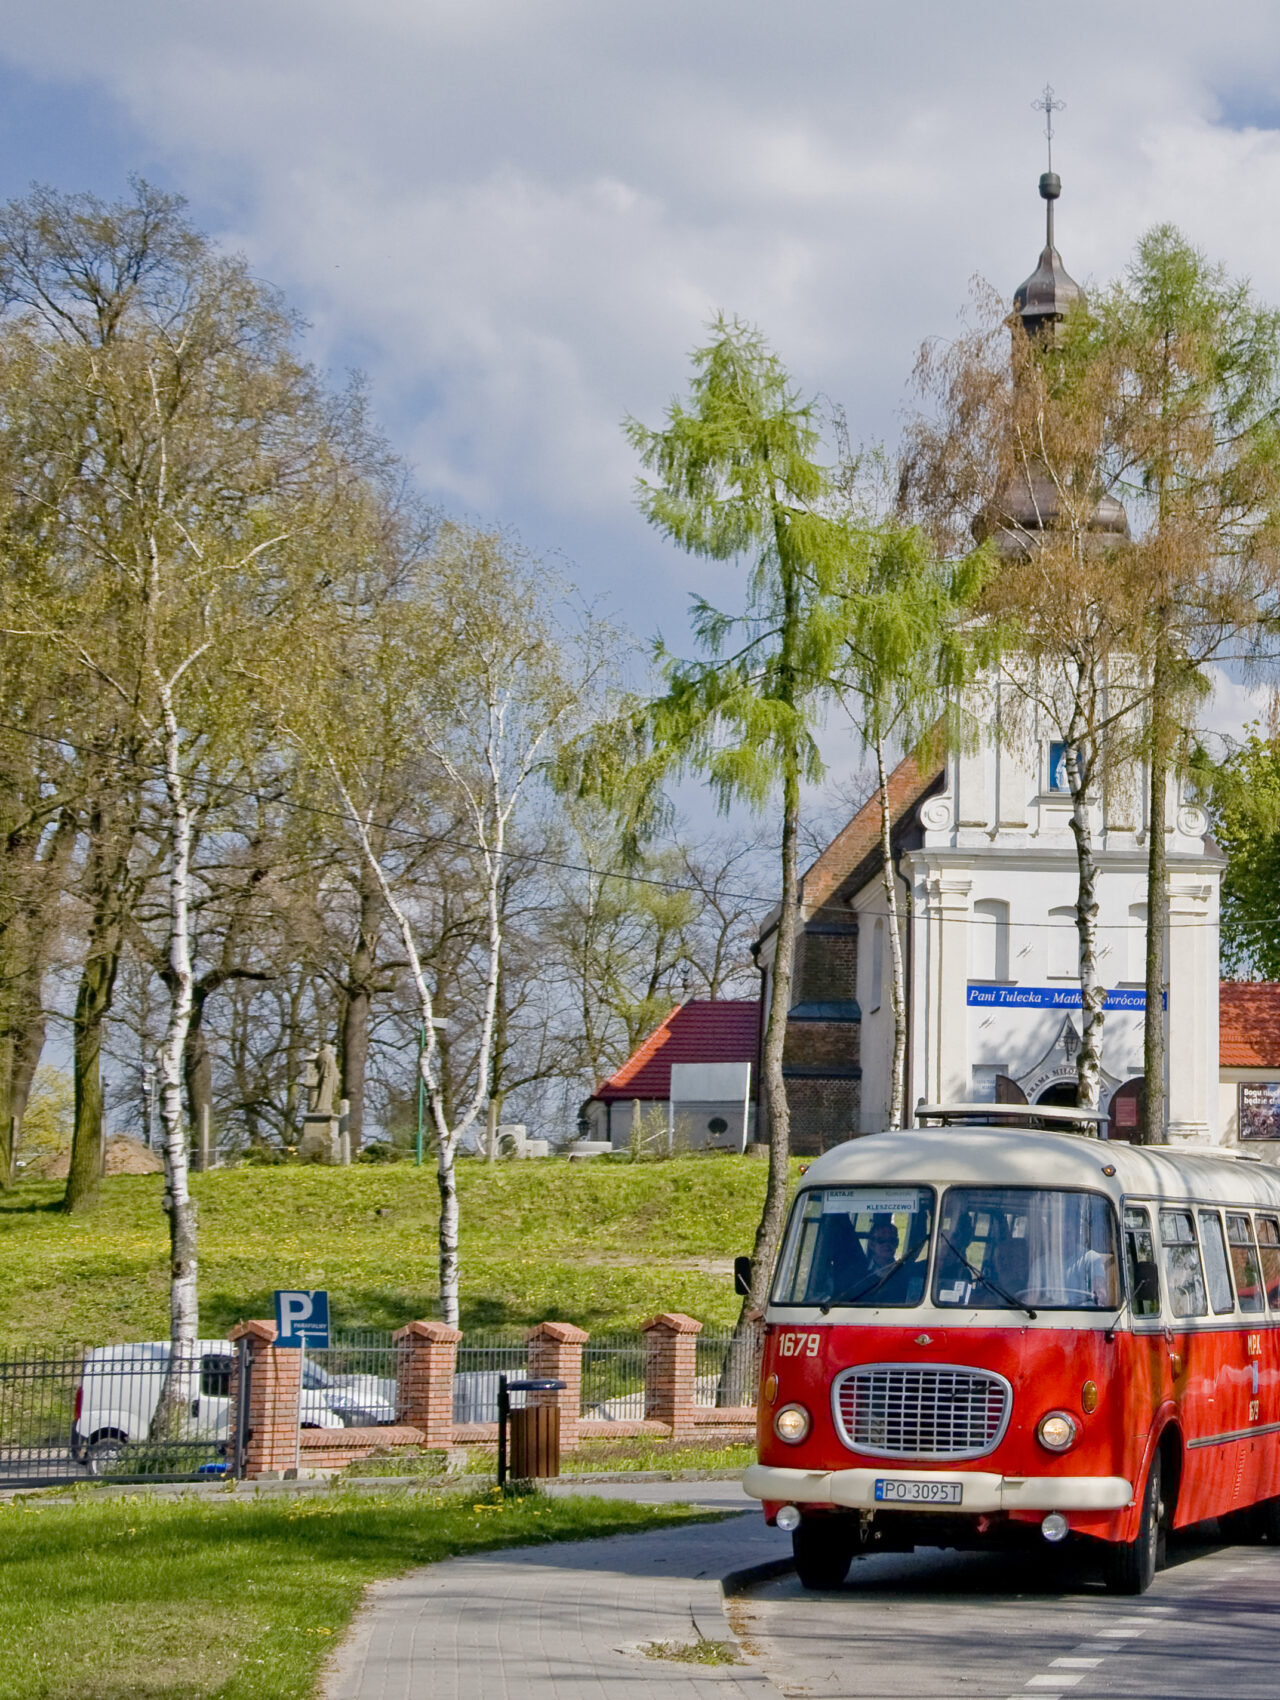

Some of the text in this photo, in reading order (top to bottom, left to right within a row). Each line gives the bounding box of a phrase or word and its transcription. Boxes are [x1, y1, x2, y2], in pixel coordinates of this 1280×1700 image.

[969, 990, 996, 1001] Pani
[1000, 991, 1041, 1003] Tulecka
[1052, 992, 1083, 1004] Matk
[1244, 1088, 1262, 1097] Bogu
[280, 1292, 313, 1337] P
[779, 1333, 820, 1357] 1679
